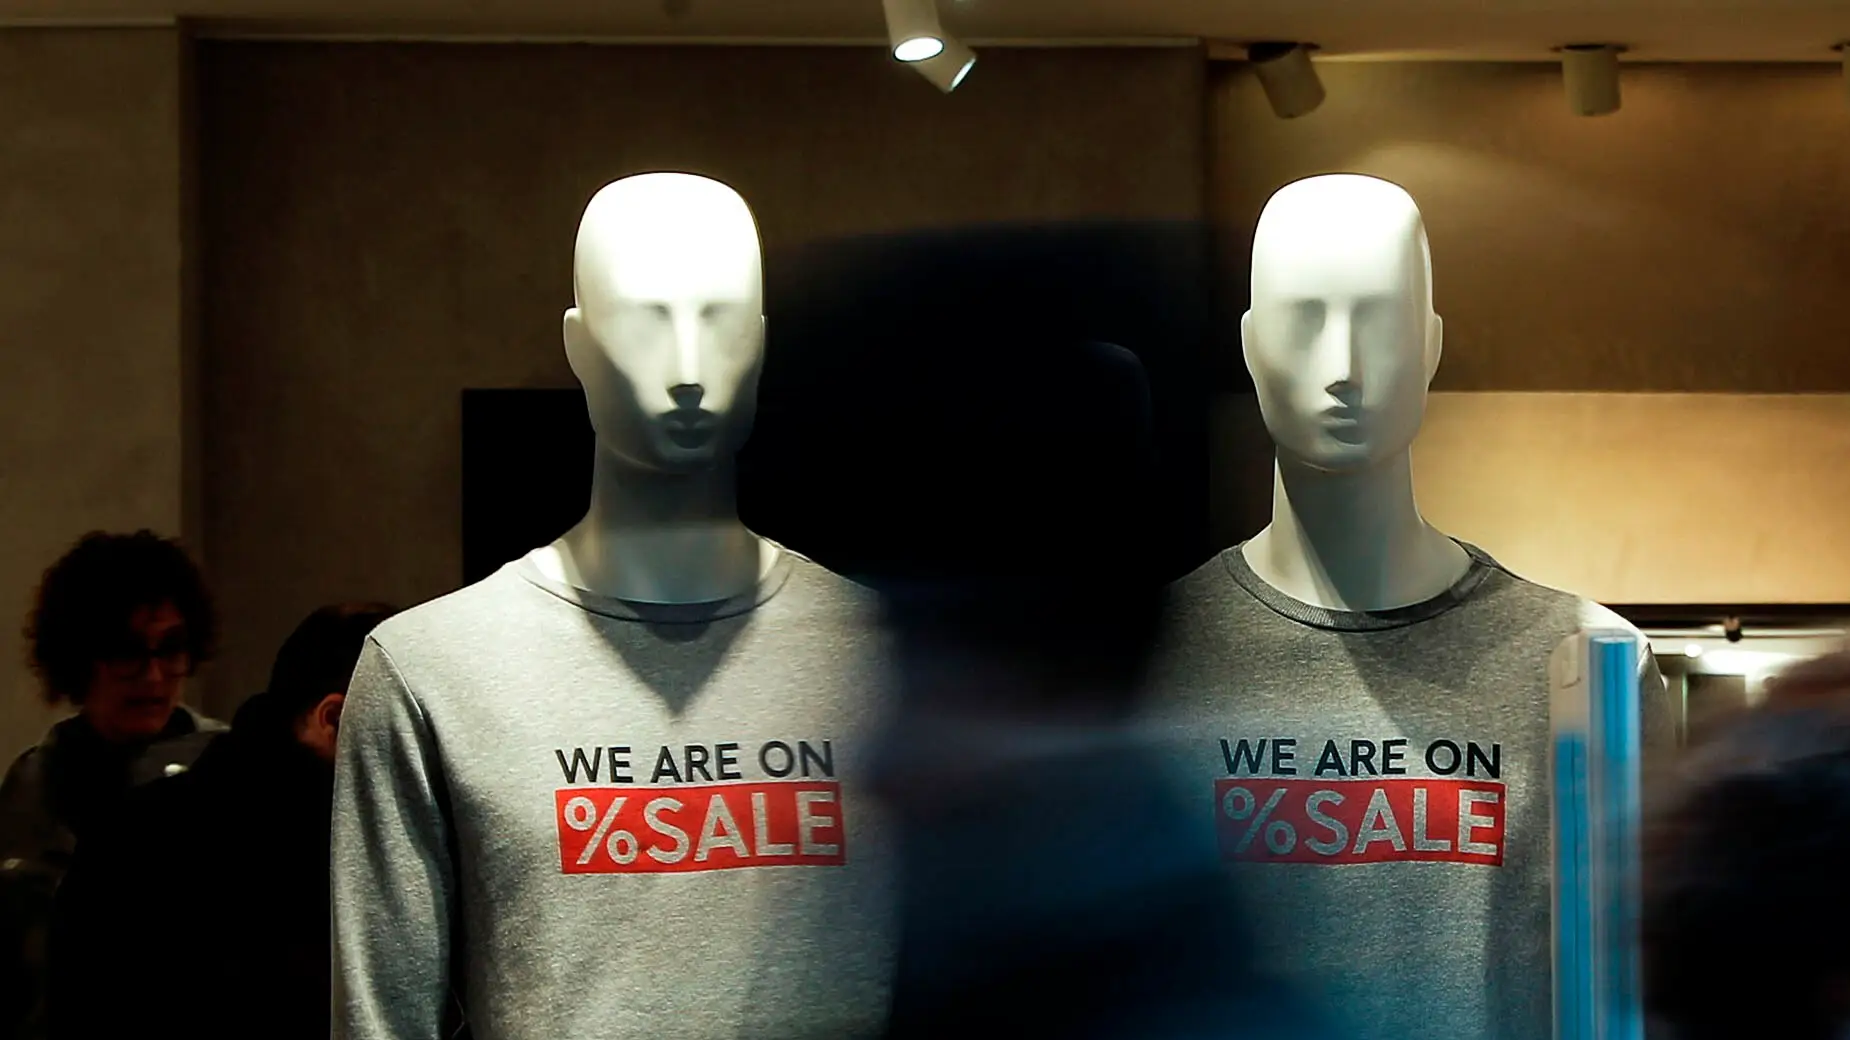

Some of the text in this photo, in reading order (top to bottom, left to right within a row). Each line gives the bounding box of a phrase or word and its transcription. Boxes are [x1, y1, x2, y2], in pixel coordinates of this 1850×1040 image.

[555, 740, 835, 784] WE ARE ON
[1220, 738, 1501, 779] WE ARE ON
[563, 790, 840, 865] %SALE
[1221, 786, 1500, 856] %SALE
